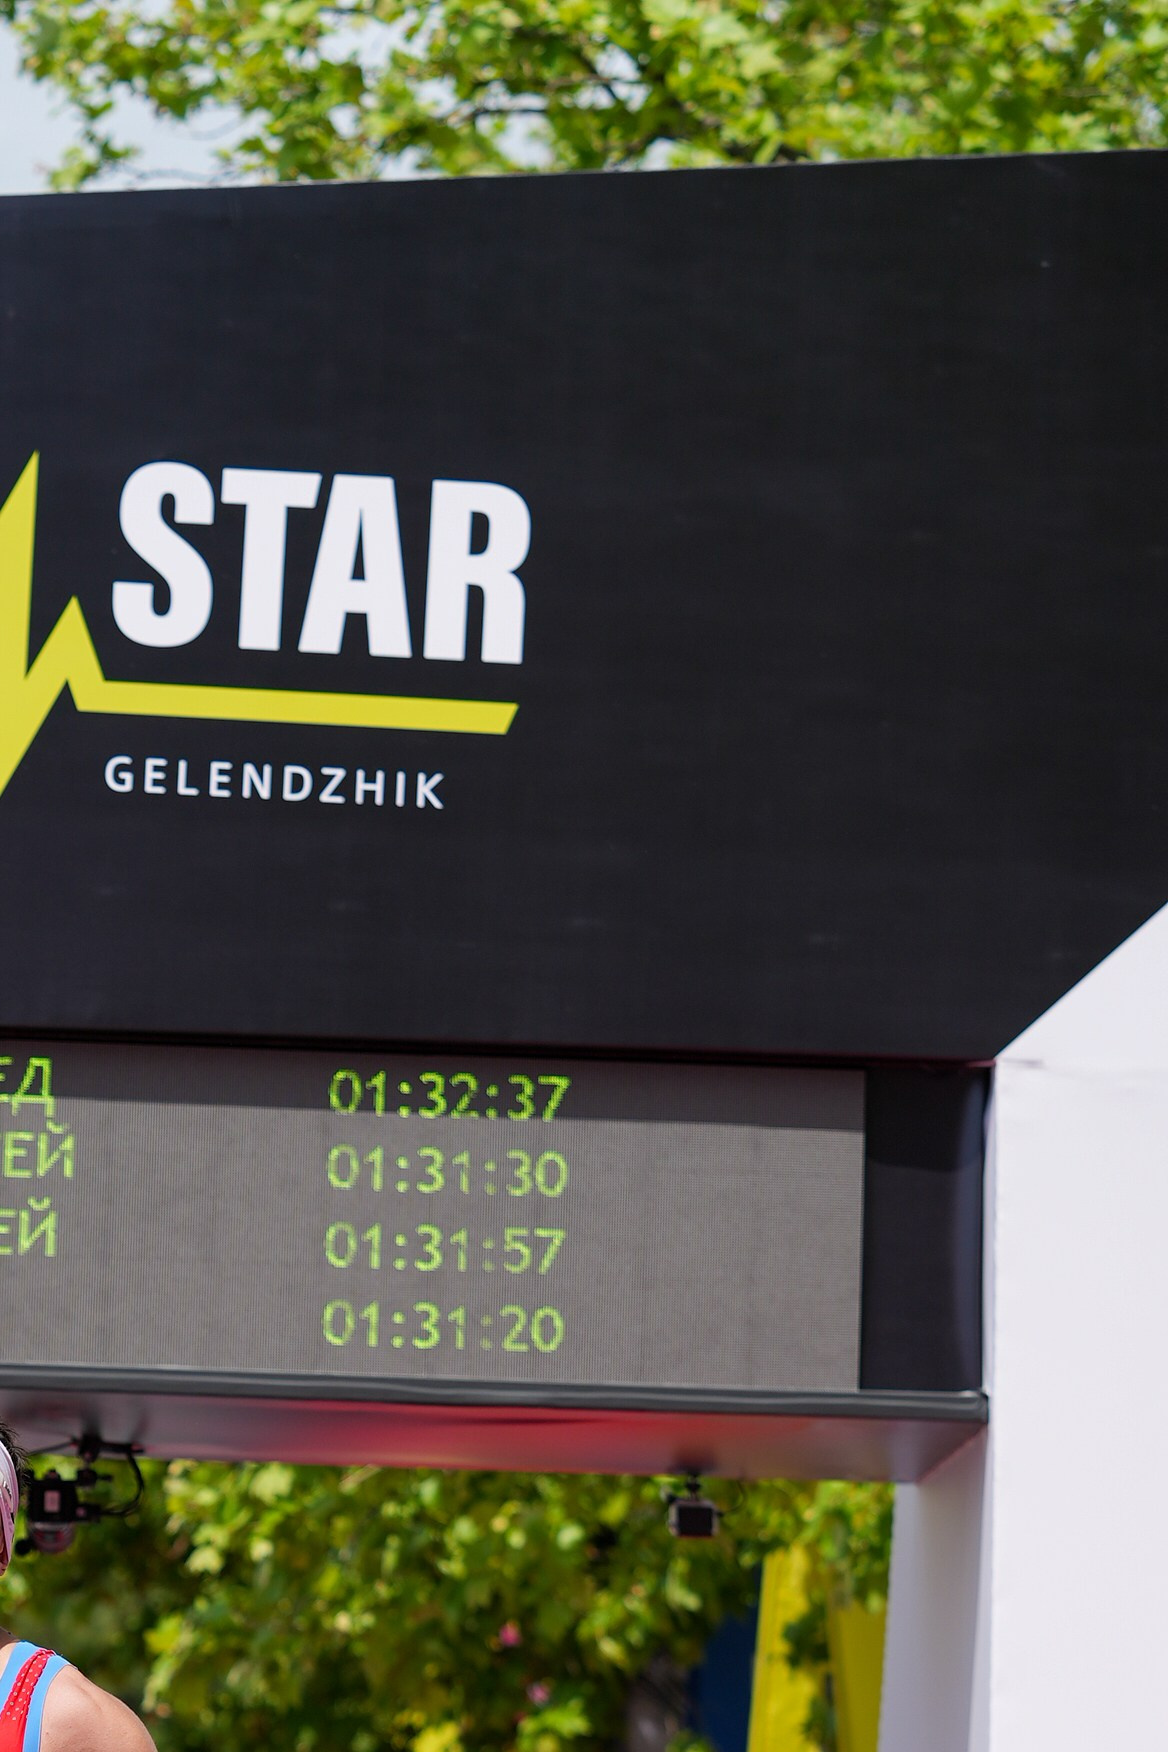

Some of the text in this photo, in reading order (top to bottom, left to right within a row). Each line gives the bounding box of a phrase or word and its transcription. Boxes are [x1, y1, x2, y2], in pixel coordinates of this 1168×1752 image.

[112, 461, 532, 664] STAR
[105, 756, 444, 809] GELENDZHIK
[329, 1069, 572, 1122] 01:32:37
[326, 1144, 569, 1198] 01:31:30
[324, 1221, 566, 1275] 01:31:57
[322, 1299, 565, 1352] 01:31:20
